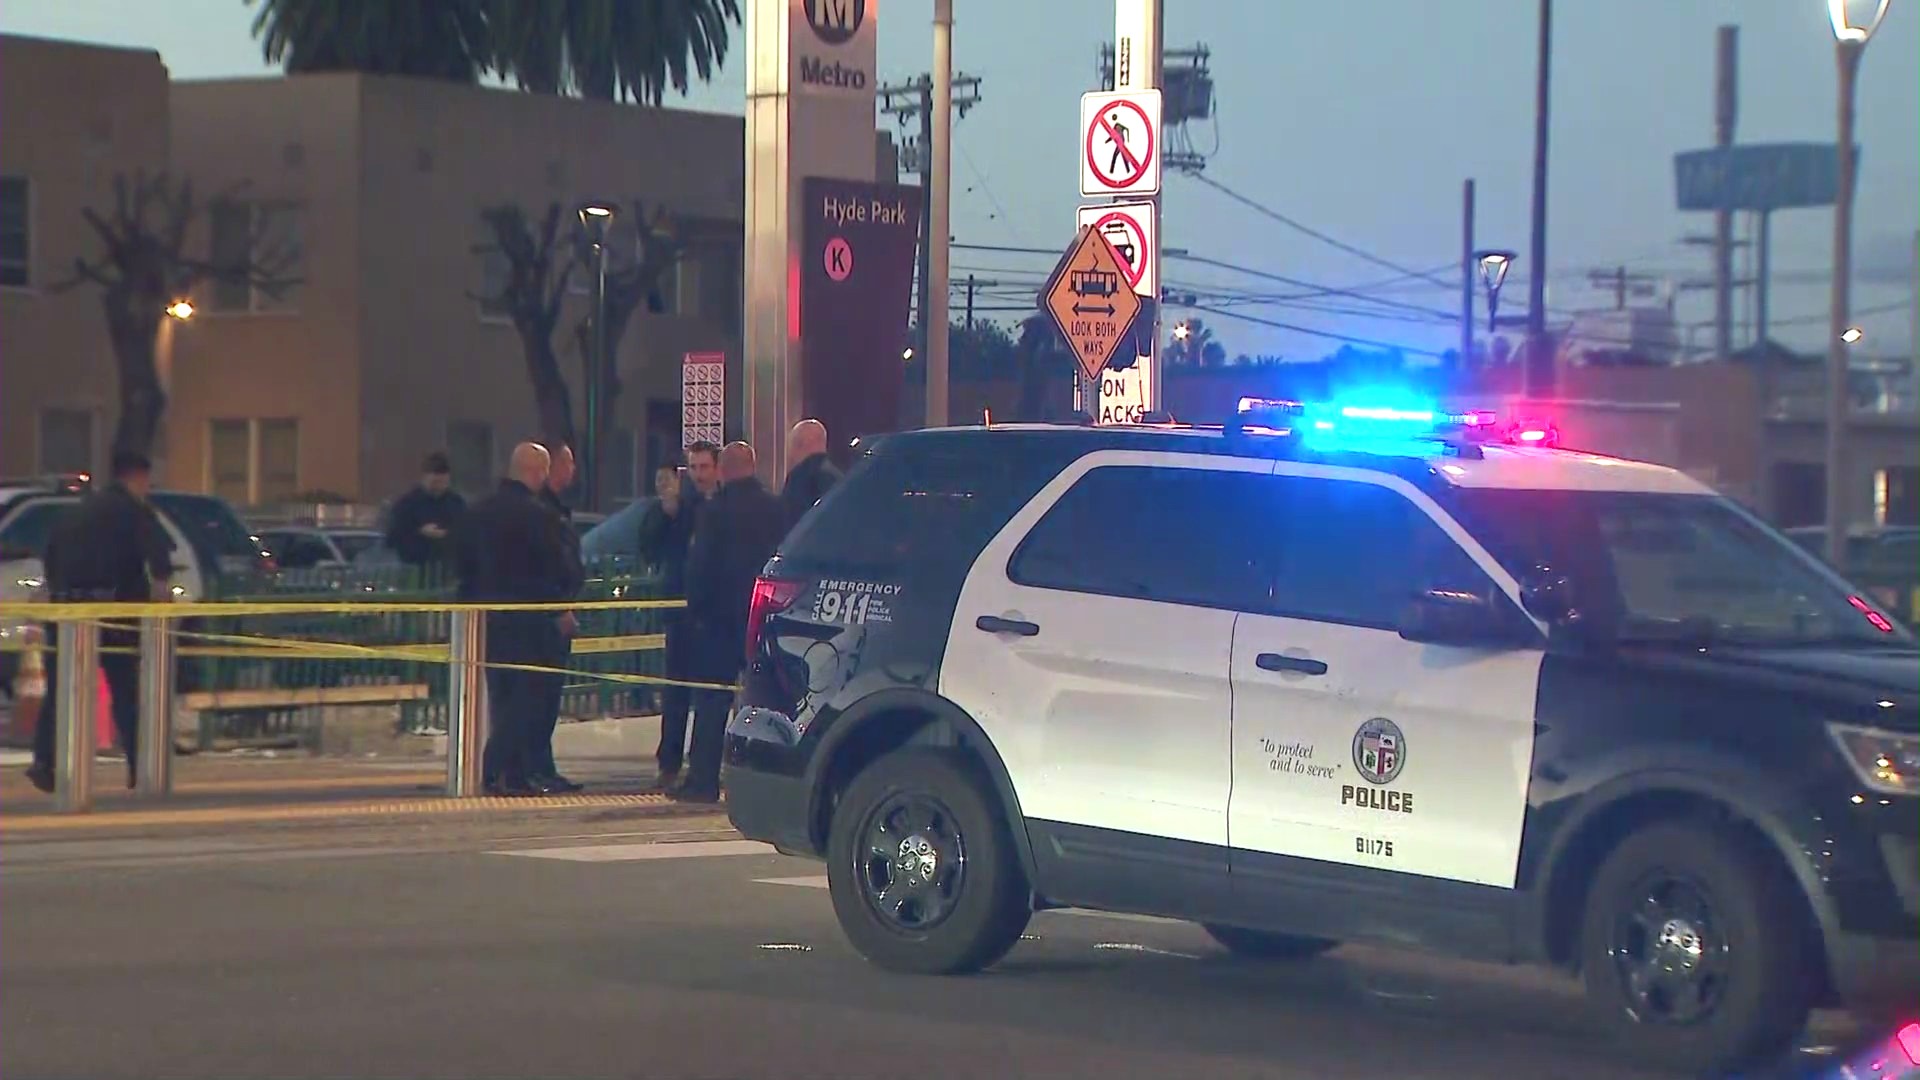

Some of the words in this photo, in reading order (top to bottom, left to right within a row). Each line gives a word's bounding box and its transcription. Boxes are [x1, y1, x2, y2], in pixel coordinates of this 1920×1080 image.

[800, 57, 865, 89] Metro
[823, 197, 865, 227] Hyde
[872, 200, 905, 225] Park
[832, 247, 846, 272] K
[1071, 321, 1092, 336] LOOK
[1095, 321, 1116, 337] BOTH
[1084, 341, 1104, 355] WAYS
[1103, 379, 1125, 397] ON
[1102, 404, 1144, 423] ACKS
[819, 579, 902, 595] EMERGENCY
[811, 590, 825, 621] CALL
[1277, 741, 1314, 760] protect
[1269, 757, 1292, 772] and
[1294, 759, 1305, 774] to
[1341, 784, 1414, 814] POLICE
[1356, 837, 1393, 857] 81175
